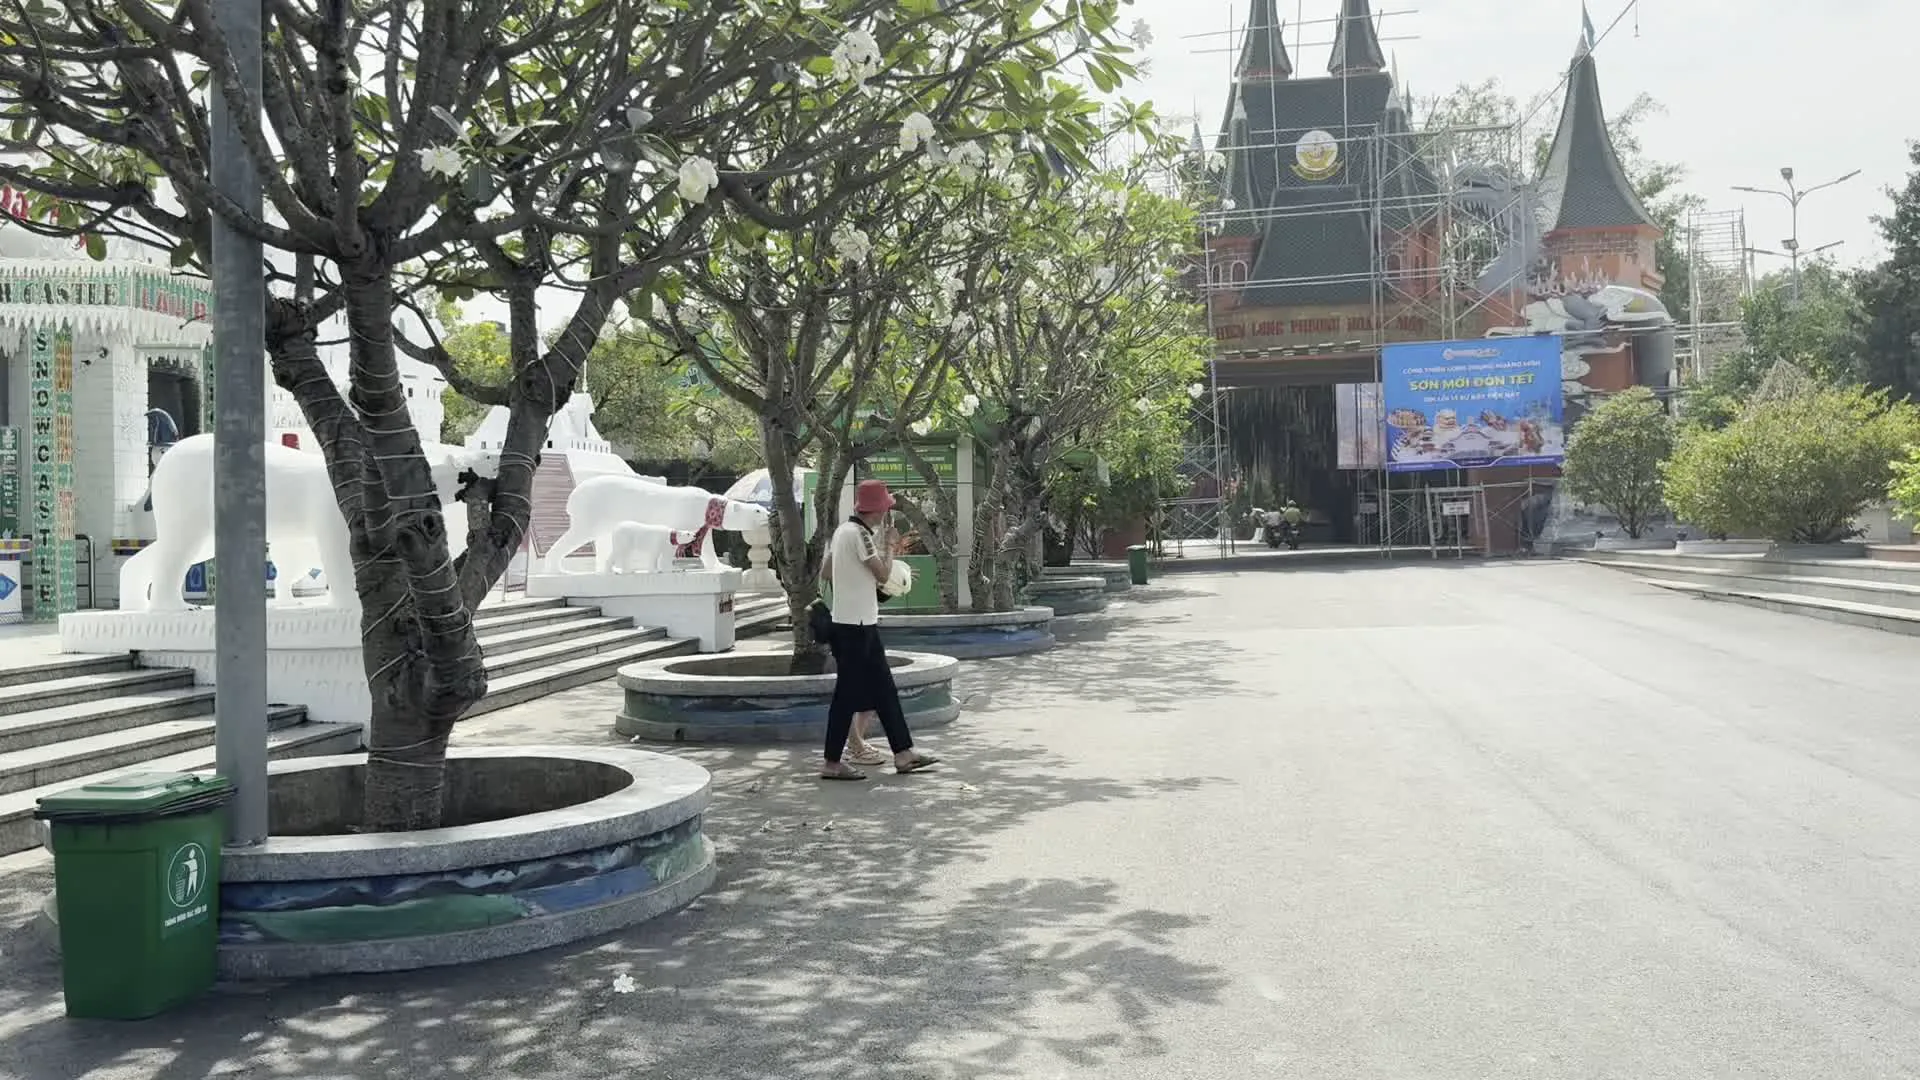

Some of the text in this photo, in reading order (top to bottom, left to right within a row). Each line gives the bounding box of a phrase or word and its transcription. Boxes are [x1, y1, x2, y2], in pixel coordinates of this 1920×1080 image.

[23, 282, 119, 304] CASTLE
[1409, 379, 1439, 391] SƠN
[1443, 376, 1470, 389] MỚI
[1509, 371, 1535, 384] TẾT
